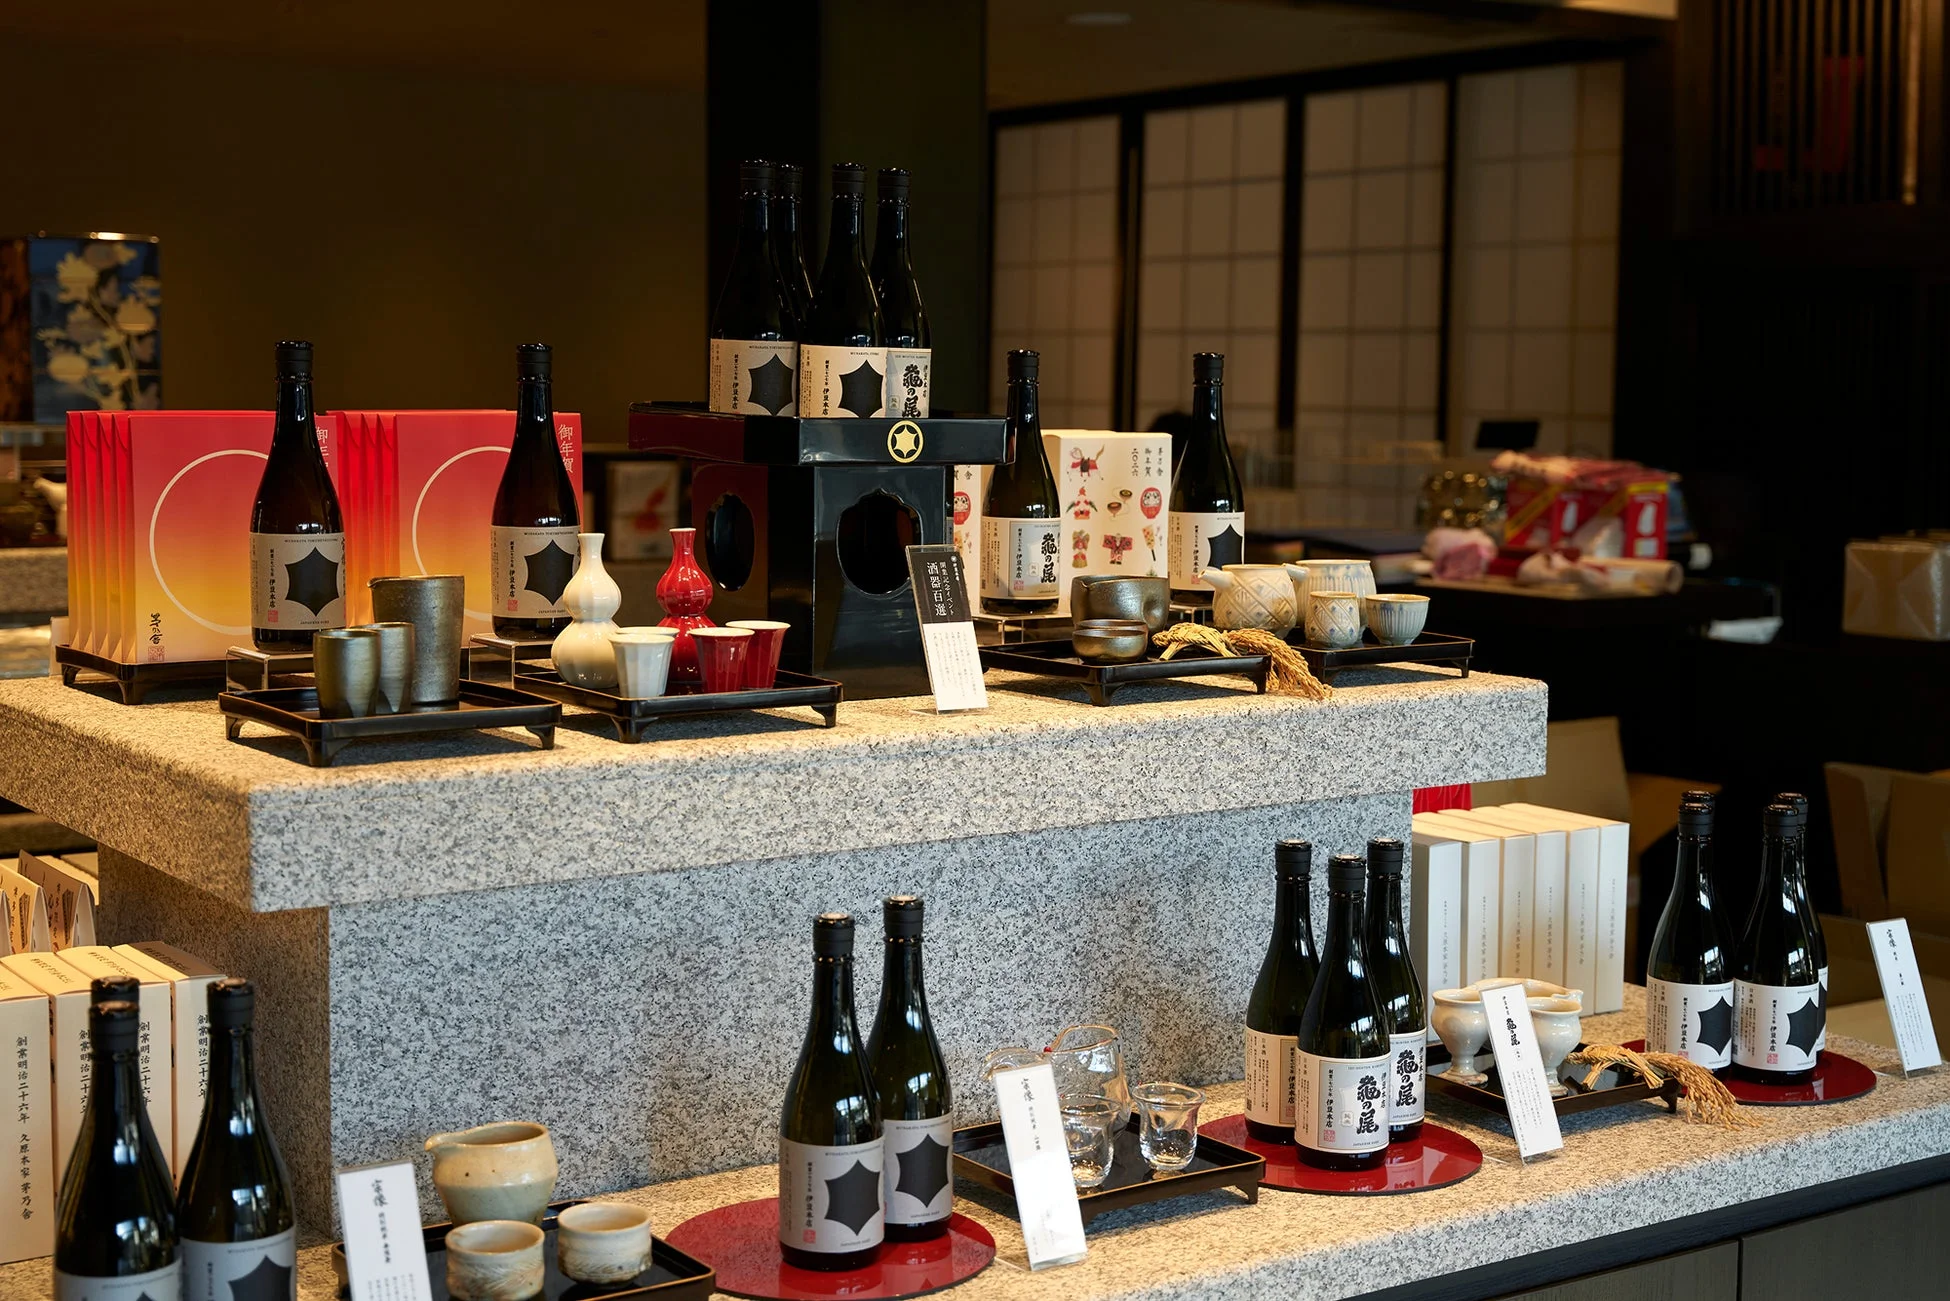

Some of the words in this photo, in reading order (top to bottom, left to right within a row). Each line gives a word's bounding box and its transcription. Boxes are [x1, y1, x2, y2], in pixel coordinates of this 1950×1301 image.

[822, 388, 830, 416] 伊豆本店
[557, 423, 575, 474] 御年賀
[926, 561, 947, 616] 酒器百選
[16, 1035, 30, 1124] 創業明治二十六年
[1325, 1098, 1334, 1128] 伊豆本店
[19, 1133, 31, 1178] 久原本家
[21, 1182, 34, 1220] 茅乃舎
